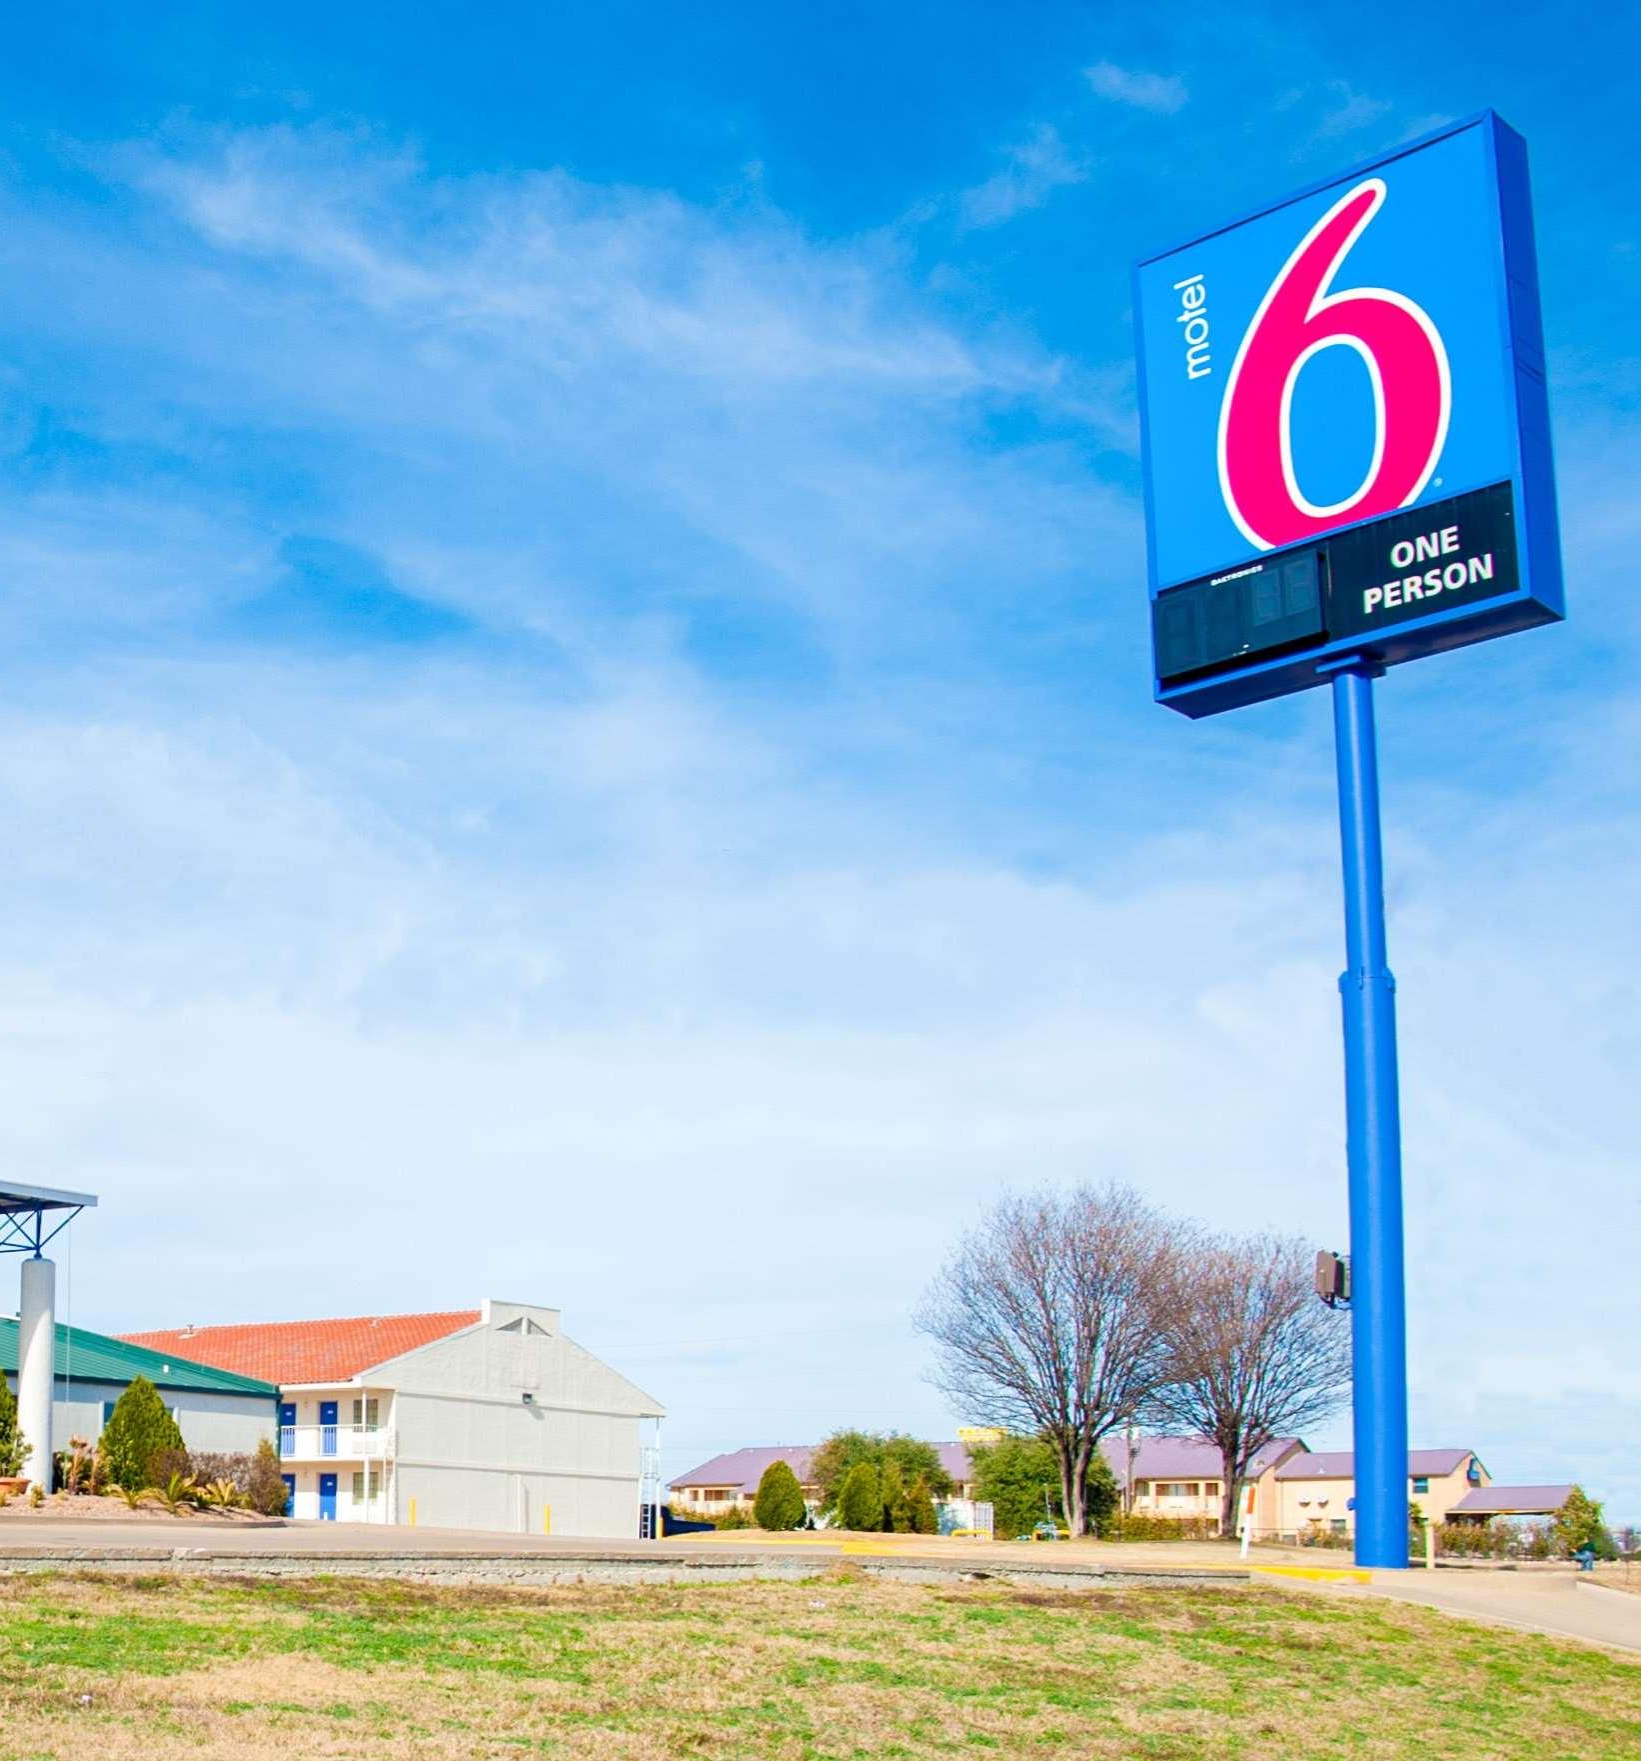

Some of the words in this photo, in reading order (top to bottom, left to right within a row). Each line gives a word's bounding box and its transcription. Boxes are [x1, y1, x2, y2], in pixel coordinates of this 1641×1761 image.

[1173, 273, 1212, 380] motel
[1216, 177, 1453, 551] 6
[1363, 553, 1493, 615] PERSON
[1390, 525, 1460, 568] ONE
